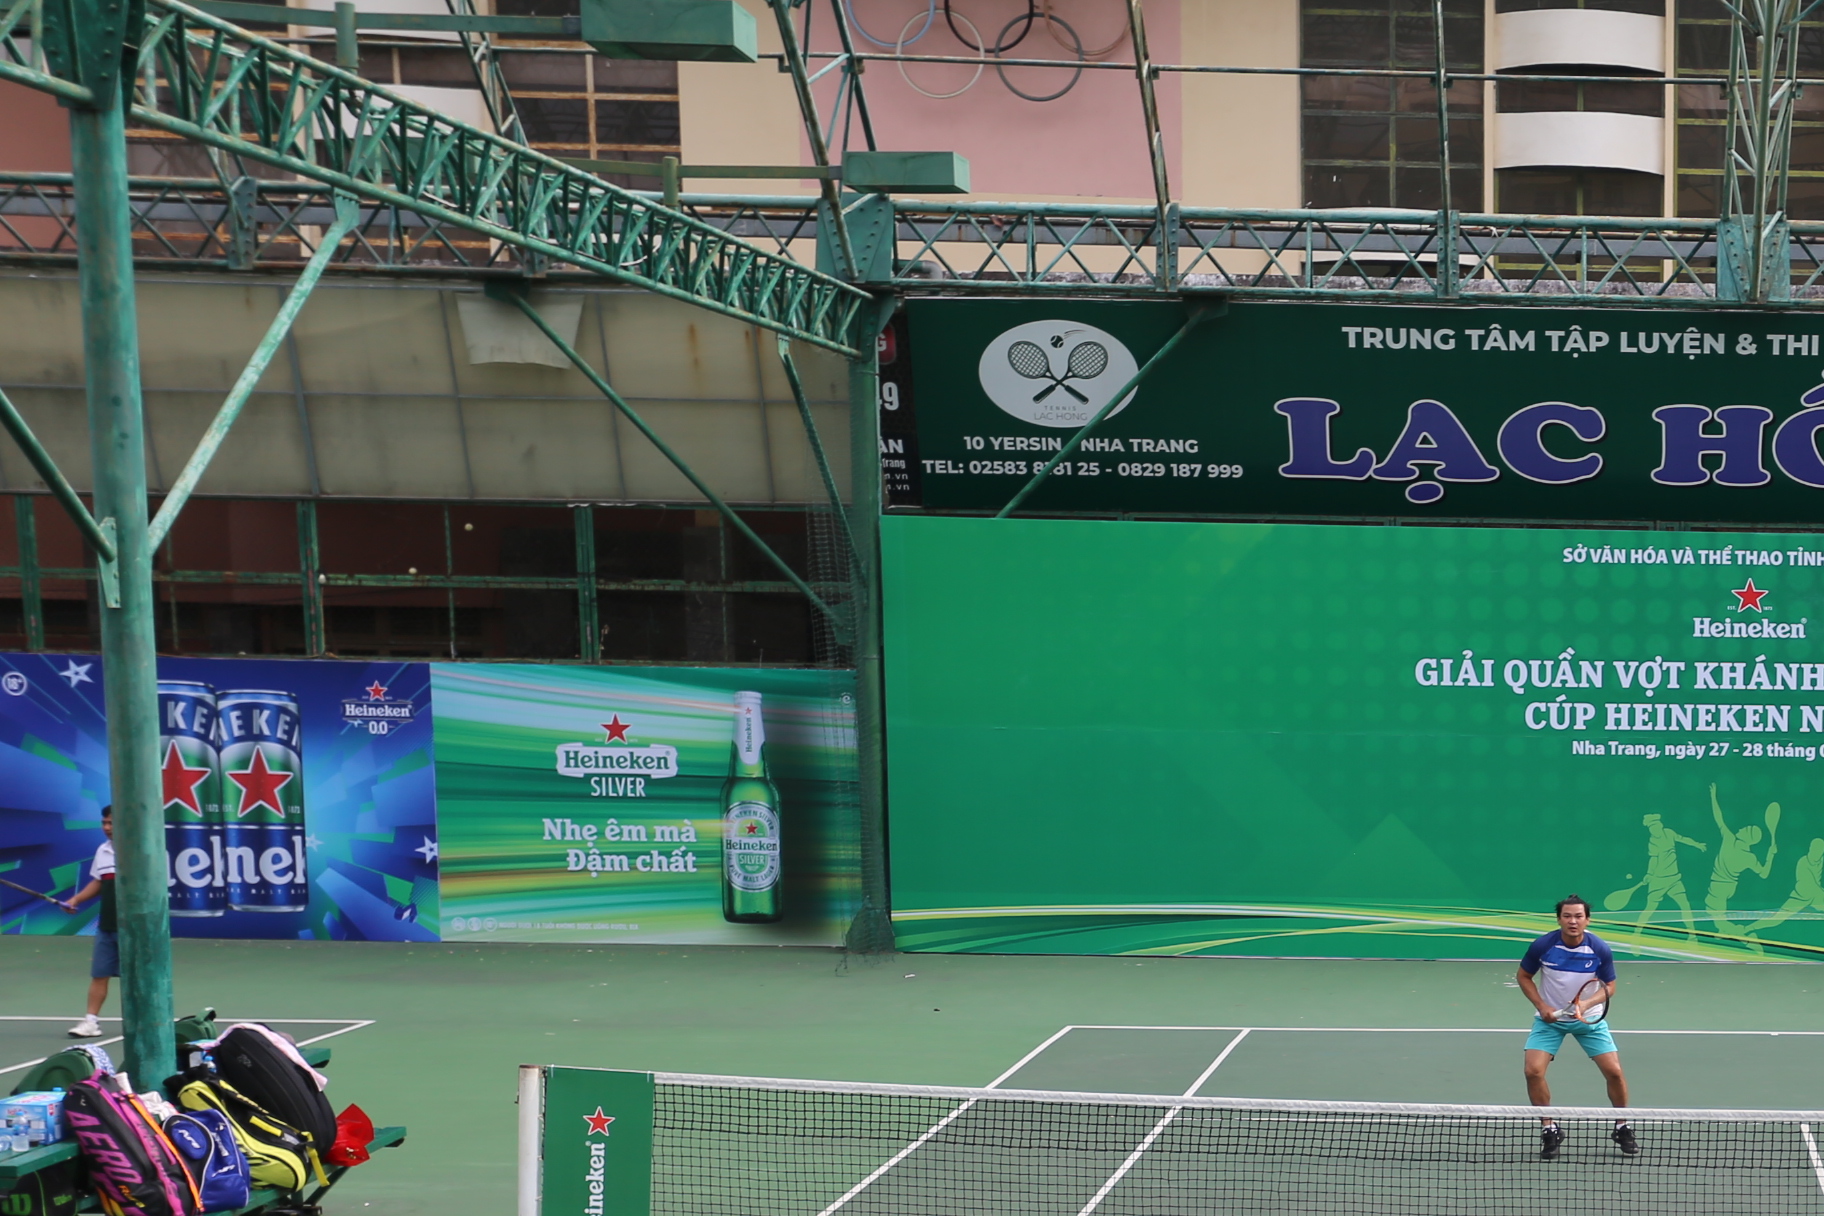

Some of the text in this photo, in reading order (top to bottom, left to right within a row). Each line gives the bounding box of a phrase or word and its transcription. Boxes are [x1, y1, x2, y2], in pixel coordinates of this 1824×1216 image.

[1341, 326, 1456, 350] TRUNG
[1465, 323, 1536, 351] TÂM
[1544, 325, 1610, 358] TẬP
[1619, 326, 1725, 360] LUYỆN
[1735, 334, 1758, 355] &
[1766, 334, 1819, 356] THI
[963, 436, 1199, 454] 10 YERSIN NHA TRANG
[1273, 397, 1606, 504] LẠC
[921, 459, 964, 475] TEL:
[968, 460, 1028, 475] 02583
[1077, 461, 1100, 476] 25
[1117, 462, 1166, 478] 0829
[1170, 463, 1202, 478] 187
[1206, 464, 1244, 479] 999
[1563, 543, 1588, 563] SỞ
[1589, 546, 1627, 564] VĂN
[1630, 545, 1668, 565] HÓA
[1671, 546, 1695, 565] VÀ
[1698, 544, 1733, 565] THỂ
[1735, 550, 1784, 566] THAO
[1692, 617, 1806, 639] Heineken
[1414, 650, 1495, 687] GIẢI
[1503, 647, 1604, 694] QUẦN
[1613, 655, 1686, 698] VỢT
[345, 703, 411, 717] Heineken
[1524, 693, 1596, 730] CÚP
[1604, 703, 1791, 732] HEINEKEN
[563, 750, 670, 770] Heineken
[1571, 740, 1605, 755] Nha
[1608, 741, 1661, 758] Trang,
[1665, 742, 1706, 760] ngày
[1709, 742, 1730, 757] 27
[1742, 742, 1763, 757] 28
[1766, 742, 1816, 761] tháng
[590, 776, 646, 798] SILVER
[542, 817, 697, 848] Nhẹ êm mà
[566, 845, 698, 878] Đậm chất
[740, 854, 765, 865] SILVER
